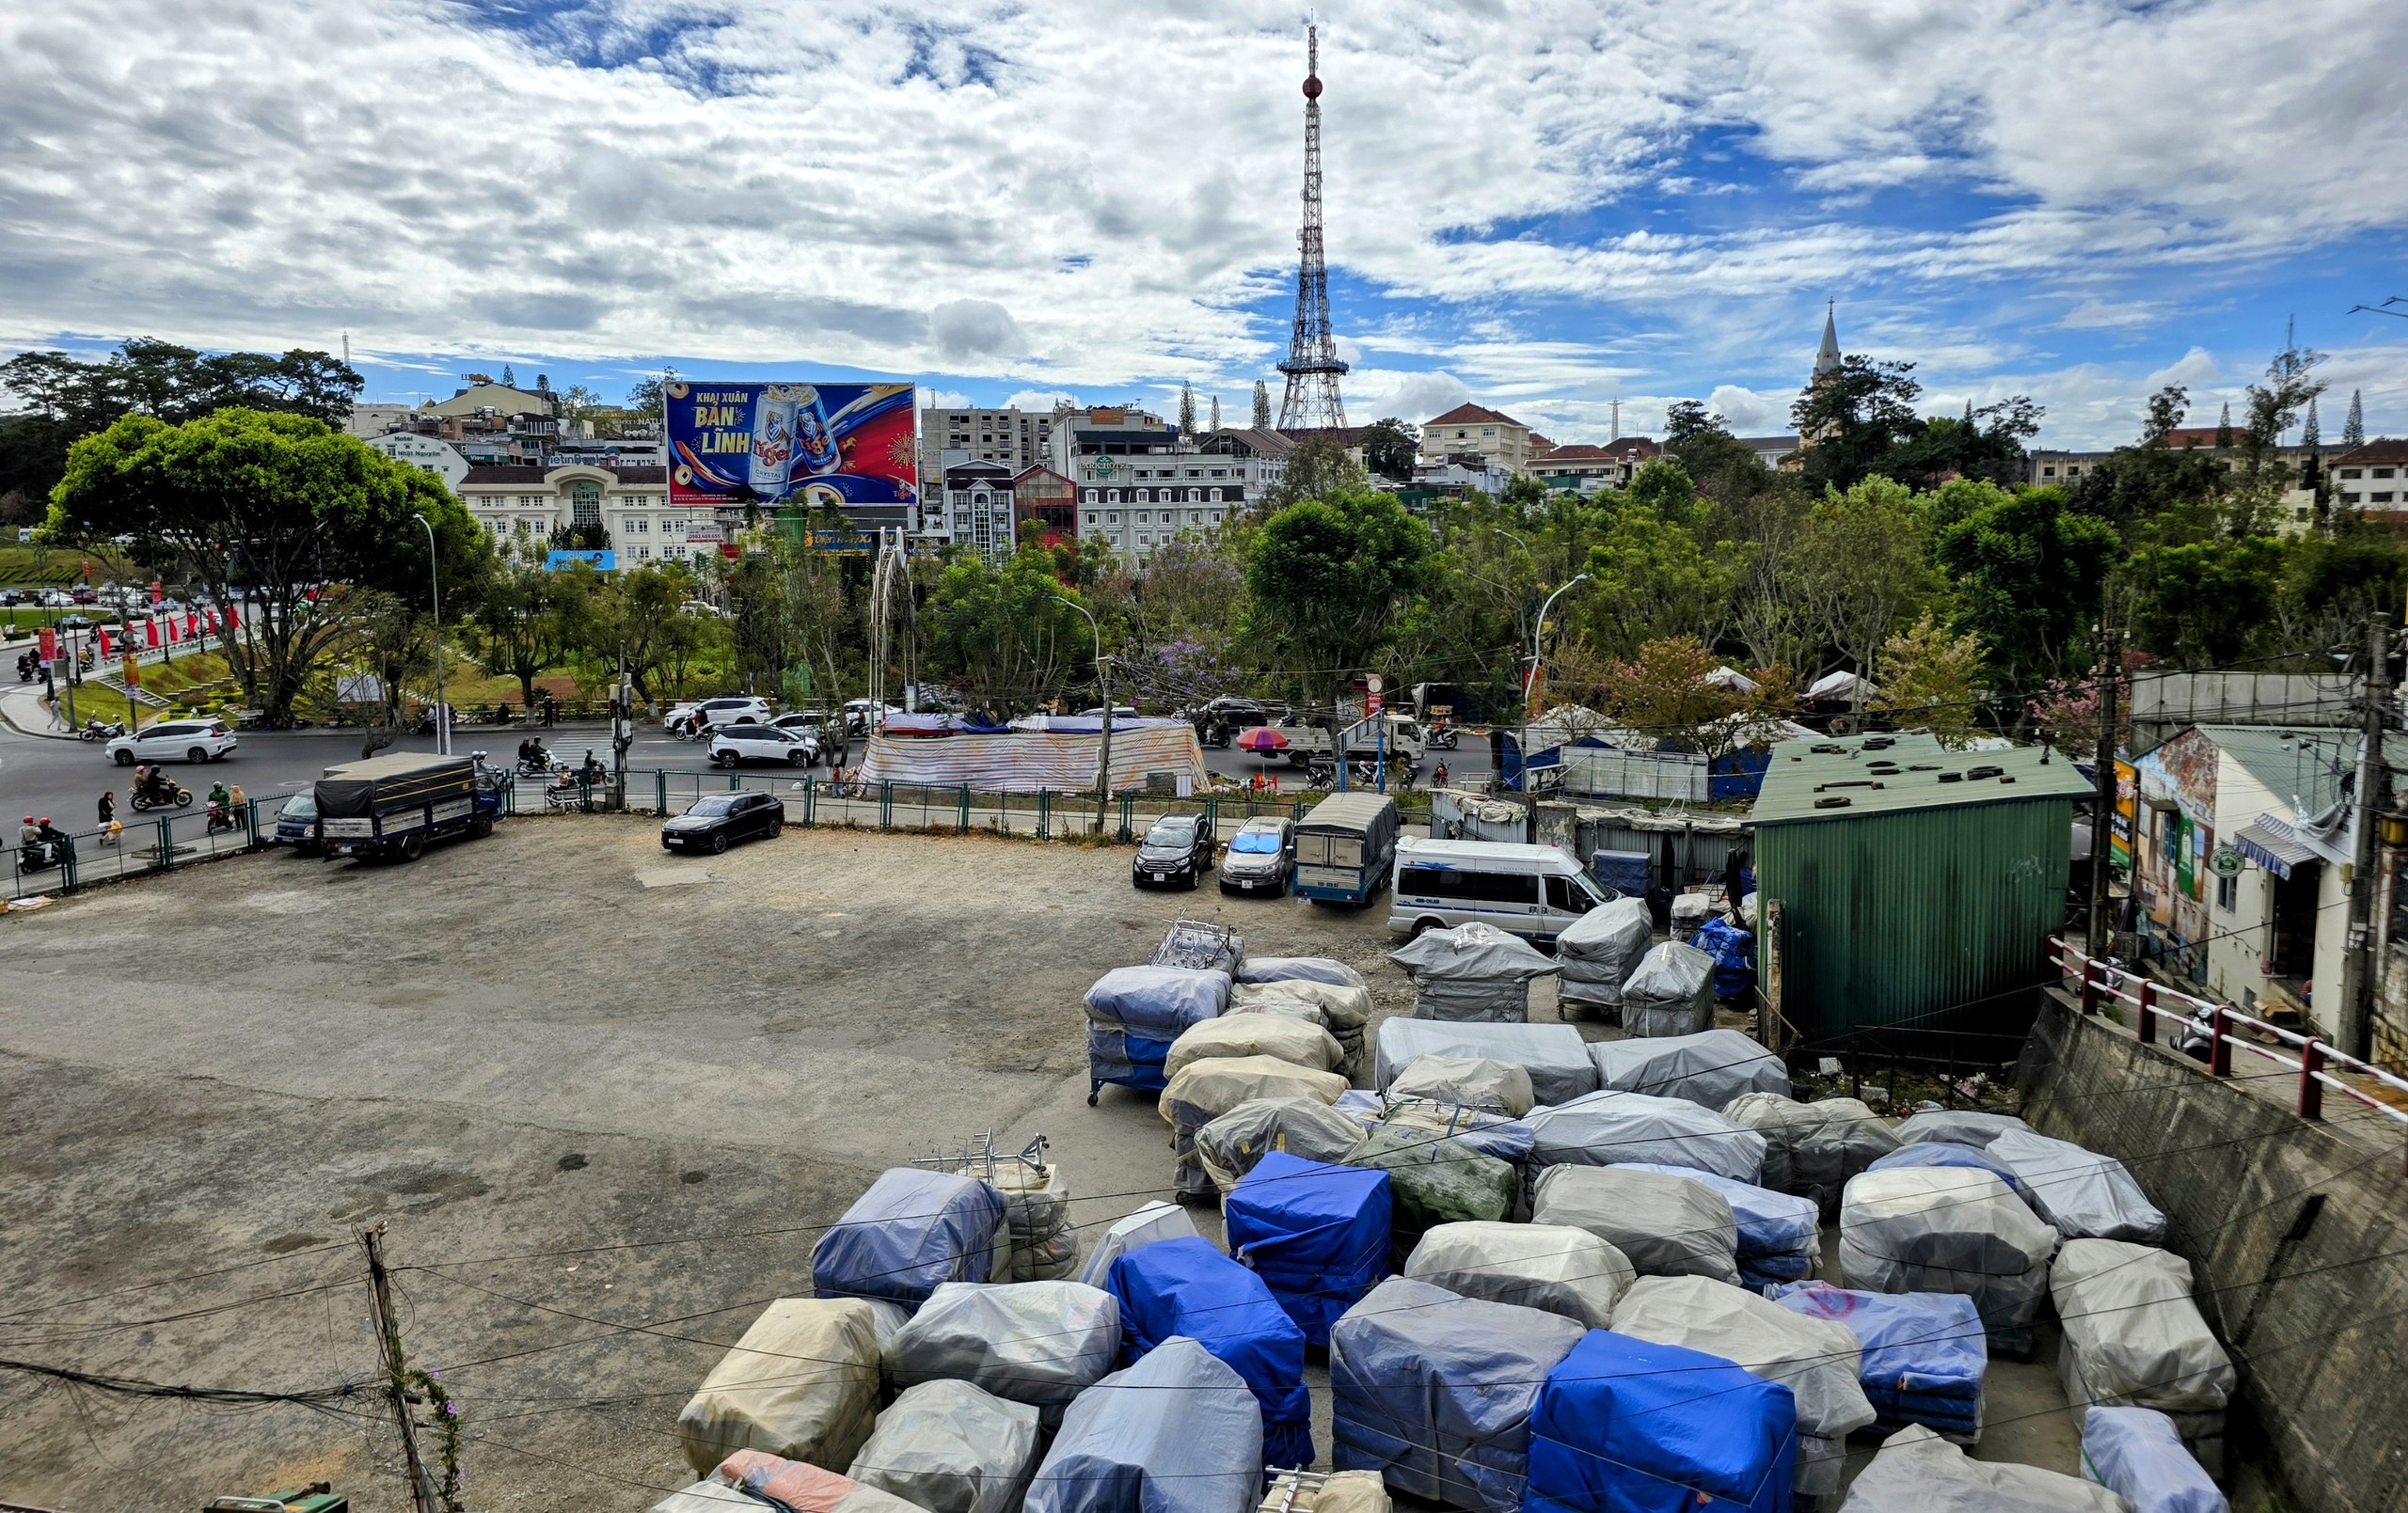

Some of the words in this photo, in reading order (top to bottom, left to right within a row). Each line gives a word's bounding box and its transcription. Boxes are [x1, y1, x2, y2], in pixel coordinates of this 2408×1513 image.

[696, 392, 720, 402] KHAI
[721, 390, 749, 402] XUÂN
[694, 401, 735, 428] BẢN
[701, 427, 751, 454] LĨNH
[755, 469, 782, 479] CRYSTAL
[893, 489, 912, 499] Tiger
